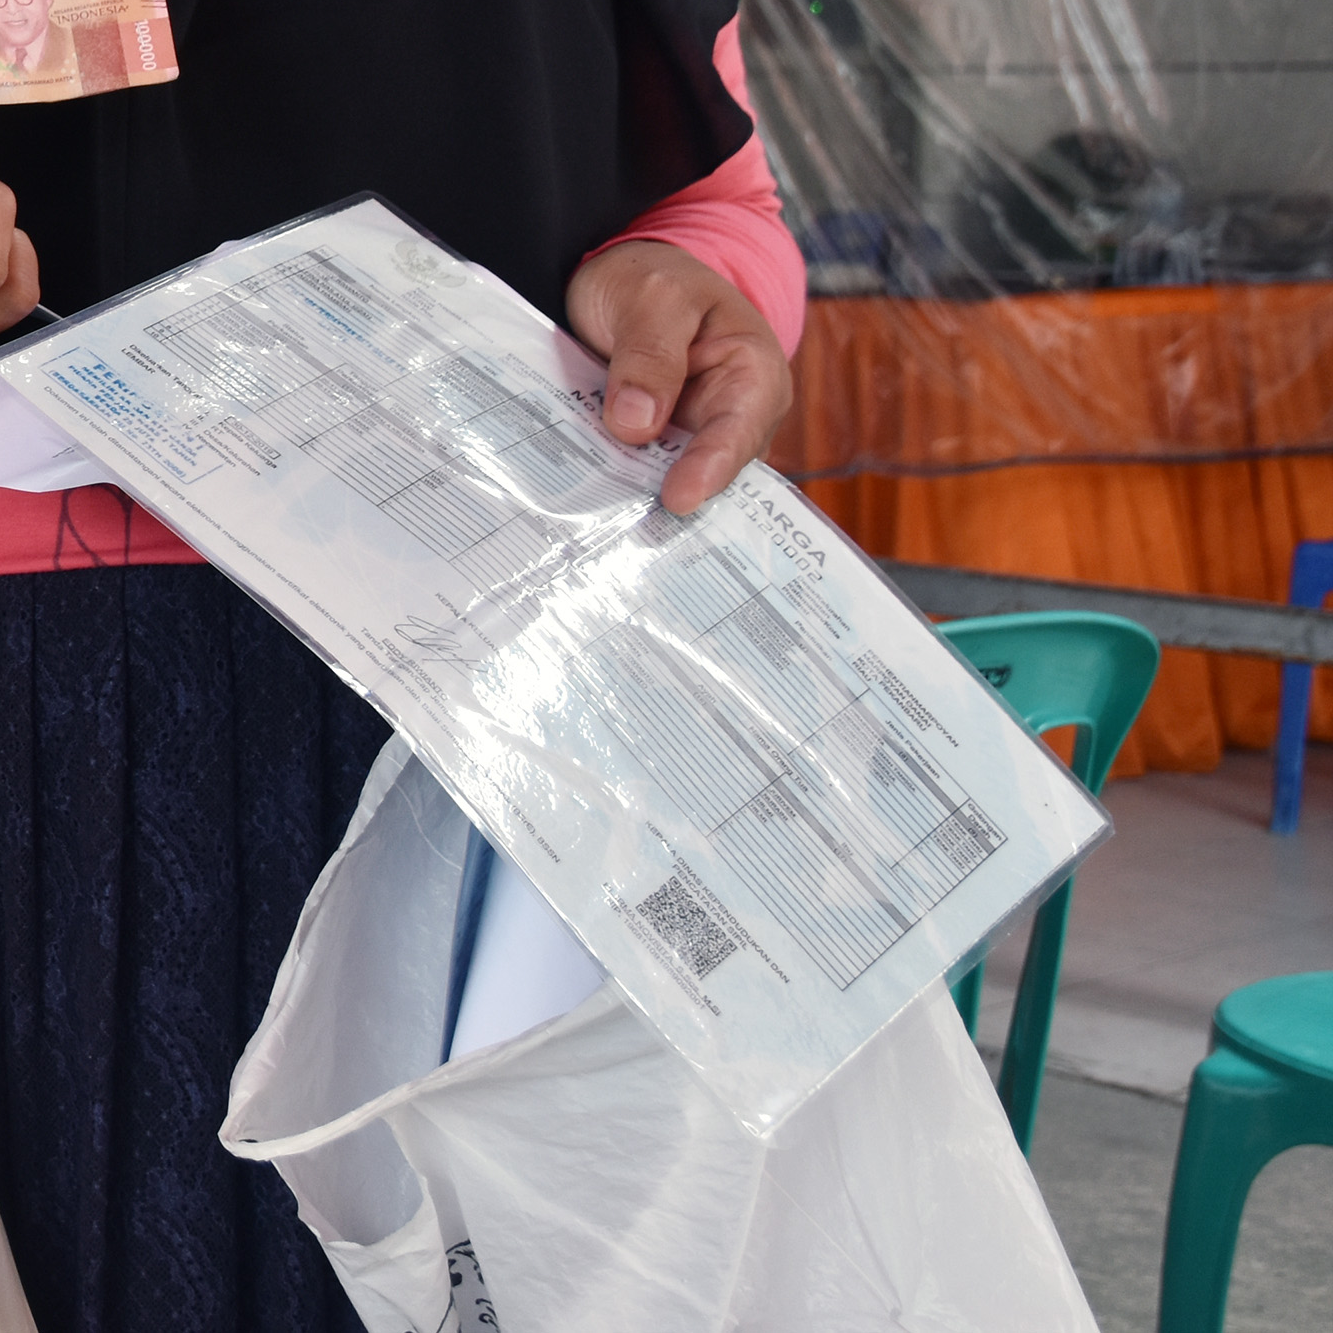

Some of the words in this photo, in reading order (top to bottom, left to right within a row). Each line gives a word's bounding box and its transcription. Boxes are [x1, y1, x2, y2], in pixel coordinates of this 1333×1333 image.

[56, 5, 129, 24] INDONESIA
[42, 384, 80, 415] Dokumen
[306, 597, 347, 633] elektronik
[669, 862, 730, 927] PENCATATAN
[725, 924, 750, 951] SIPIL
[674, 856, 704, 887] DINAS
[699, 884, 774, 963] KEPENDUDUKAN
